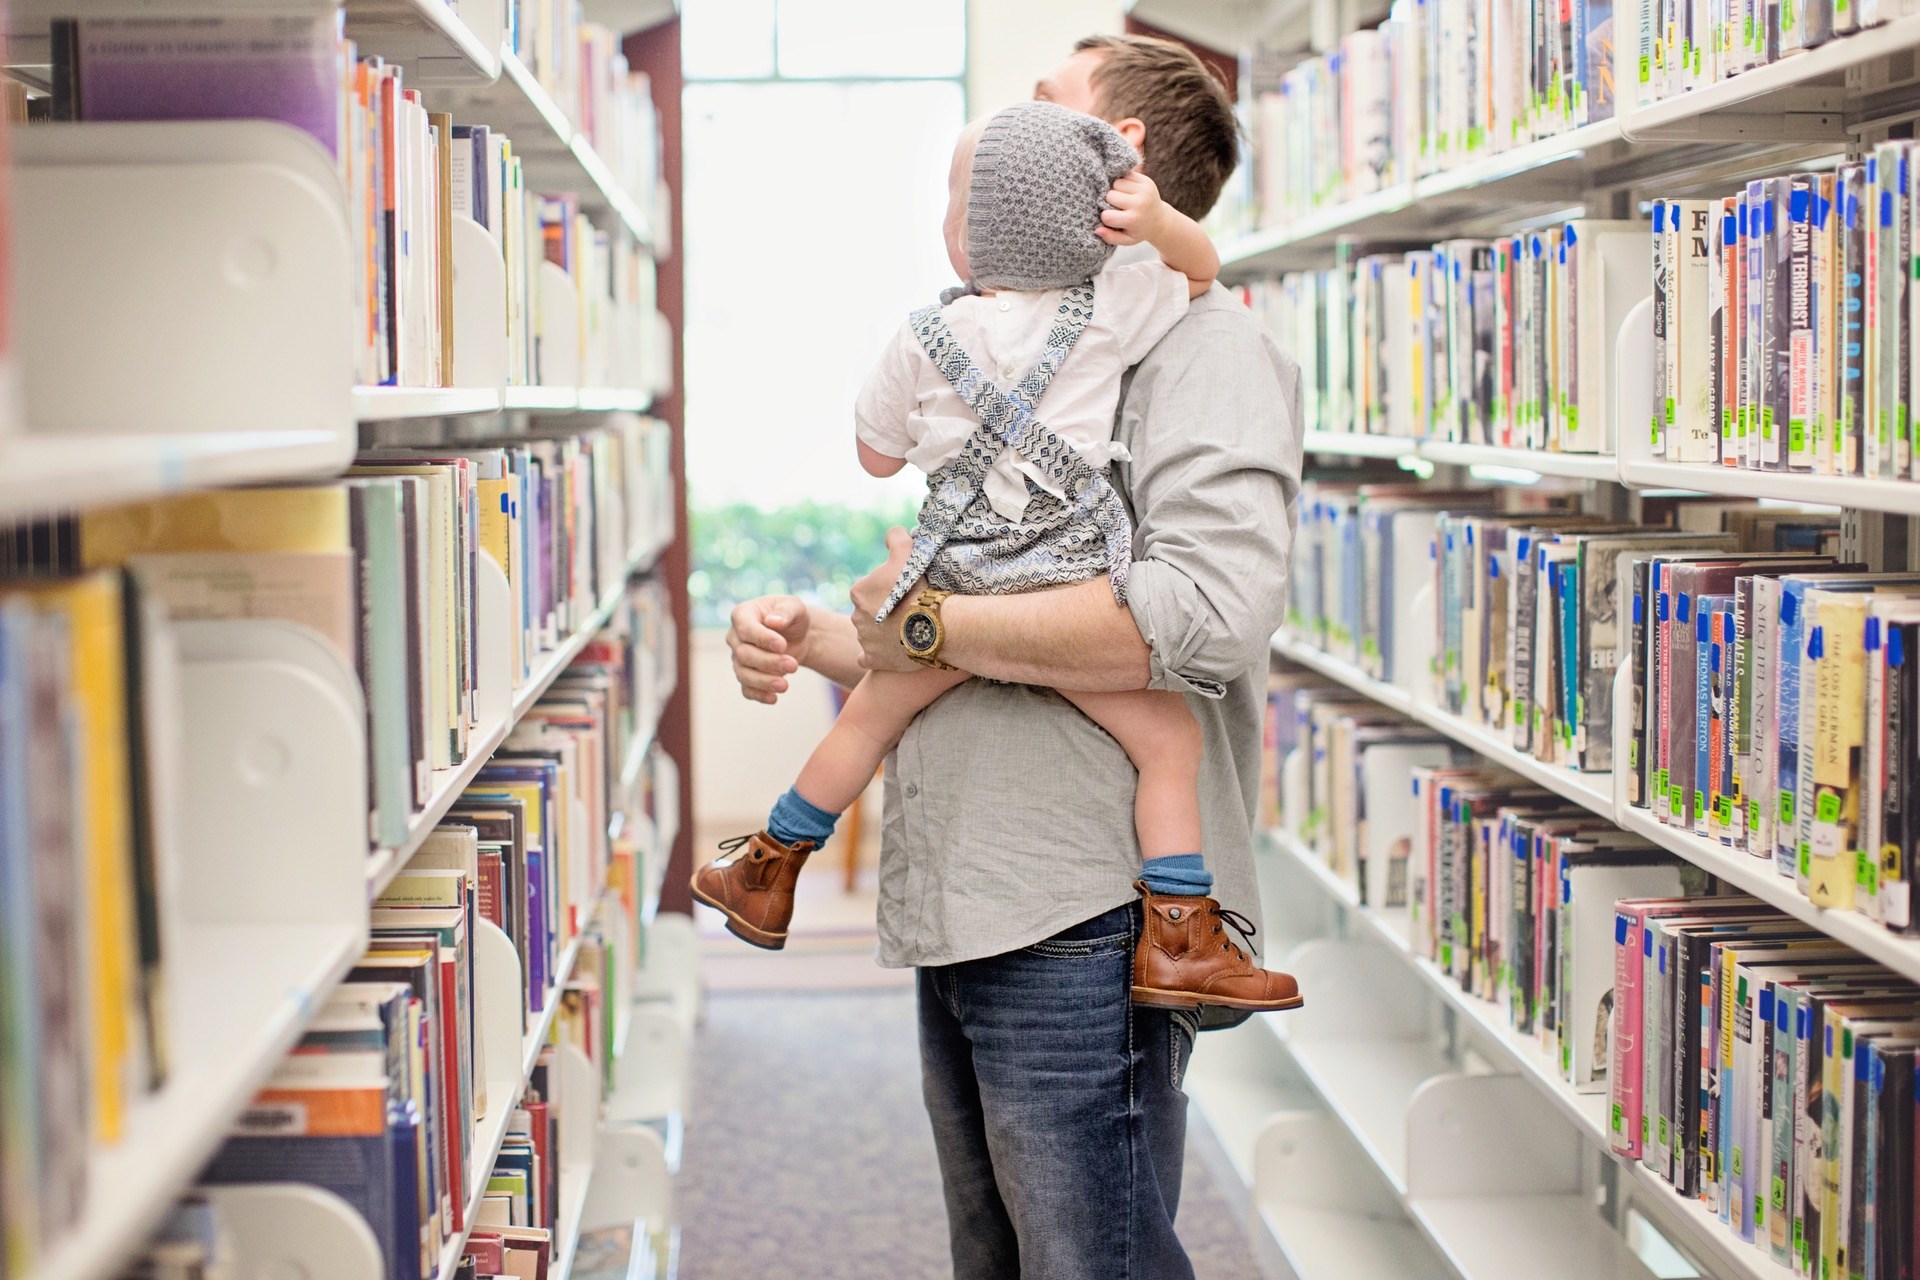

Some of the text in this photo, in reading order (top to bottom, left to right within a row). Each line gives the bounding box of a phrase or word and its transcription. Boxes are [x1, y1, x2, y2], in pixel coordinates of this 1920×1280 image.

[1640, 37, 1650, 54] HIG
[1692, 210, 1708, 231] F
[1692, 237, 1708, 258] M
[1792, 182, 1809, 328] ACAN TERRORIST
[1667, 271, 1675, 326] McCourt
[1764, 269, 1776, 393] Sister Aimee
[1655, 301, 1665, 397] Singing My Him Song
[1799, 337, 1807, 365] TIMOTHY
[1692, 430, 1709, 440] Te
[1734, 590, 1745, 676] AL MICHAELS
[1662, 687, 1669, 697] OF
[1662, 698, 1668, 712] MY
[1699, 650, 1708, 752] THOMAS MERTON
[1754, 603, 1766, 774] MICHELANGELO
[1779, 660, 1790, 747] IS MY HOME
[1789, 664, 1801, 752] THE WORLD
[1819, 657, 1830, 735] SLAVE GIRL
[1829, 633, 1842, 765] THE LOST GERMAN
[1889, 668, 1898, 714] AZALEA
[1889, 781, 1897, 802] MIN
[1615, 934, 1636, 1028] Southern
[1613, 1031, 1634, 1106] Daught
